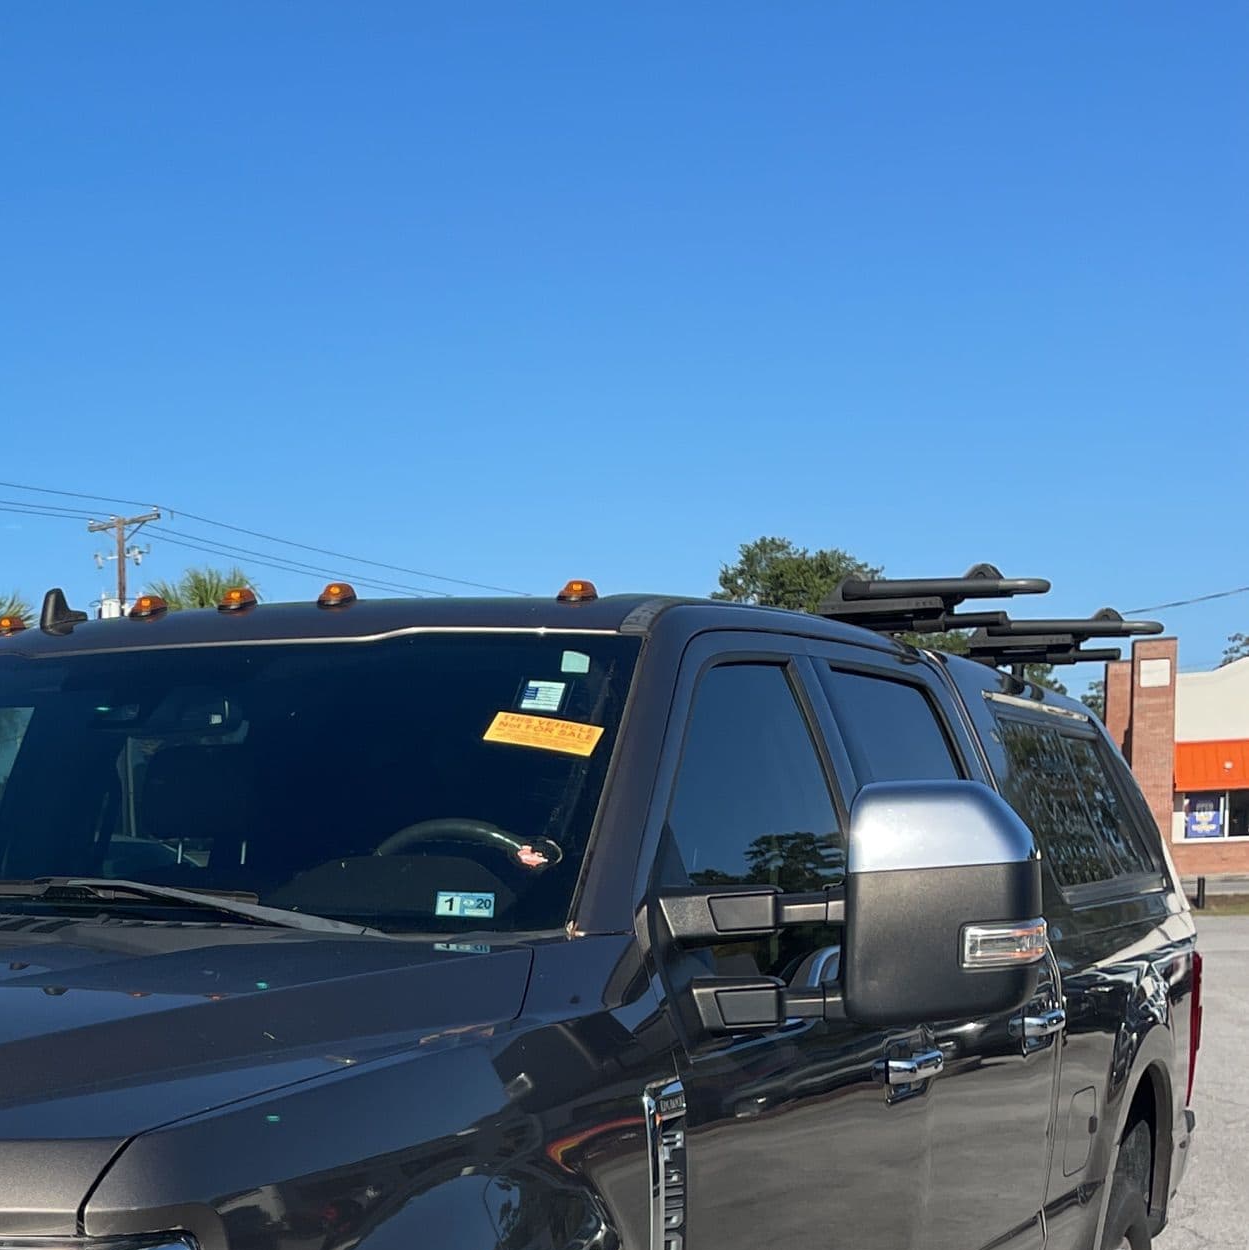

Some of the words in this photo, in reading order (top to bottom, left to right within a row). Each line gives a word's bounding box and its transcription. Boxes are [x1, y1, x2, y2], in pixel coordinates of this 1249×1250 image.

[526, 724, 553, 733] FOR
[558, 729, 592, 740] SALE
[445, 897, 454, 911] 1
[476, 898, 492, 910] 20
